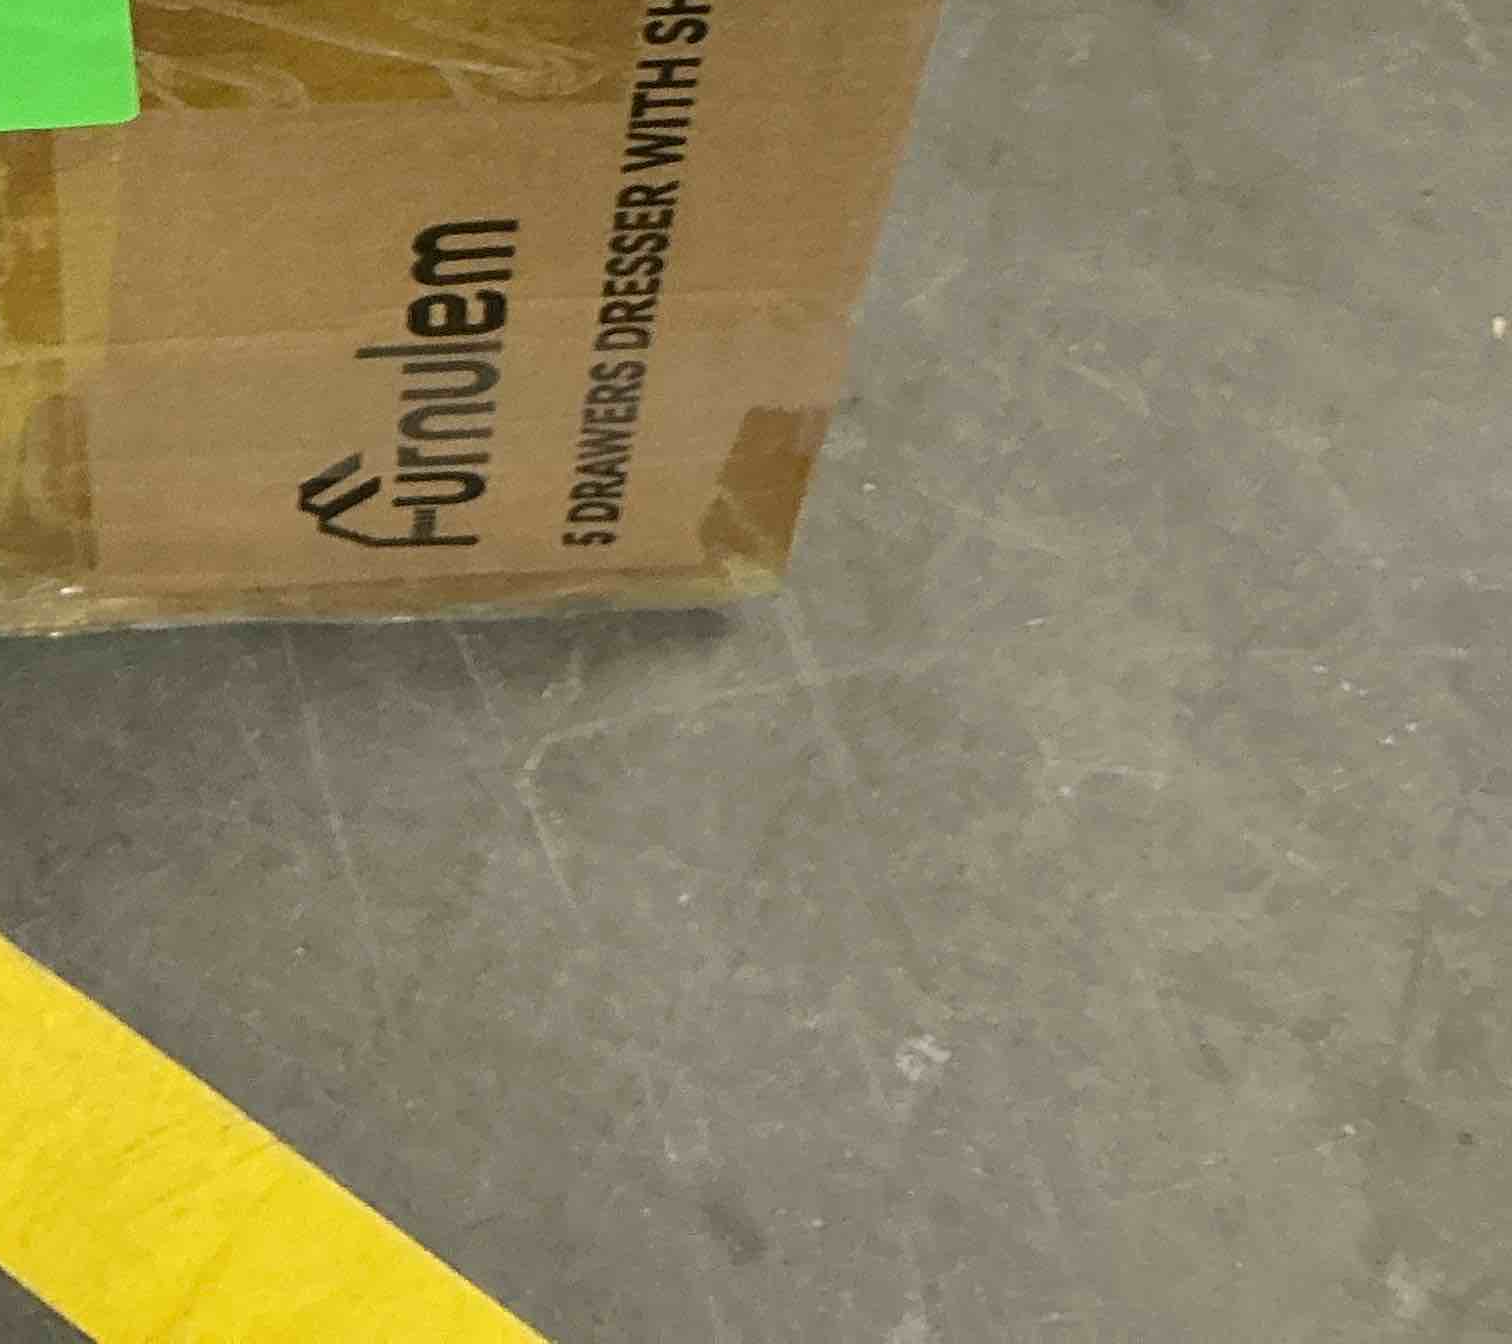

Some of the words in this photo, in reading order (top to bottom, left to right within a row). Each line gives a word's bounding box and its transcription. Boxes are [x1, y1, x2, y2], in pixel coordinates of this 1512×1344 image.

[620, 56, 704, 175] WITH
[595, 180, 681, 353] DRESSER
[297, 218, 520, 549] Furnulem
[566, 361, 646, 526] DRAWERS
[561, 530, 617, 548] 5
